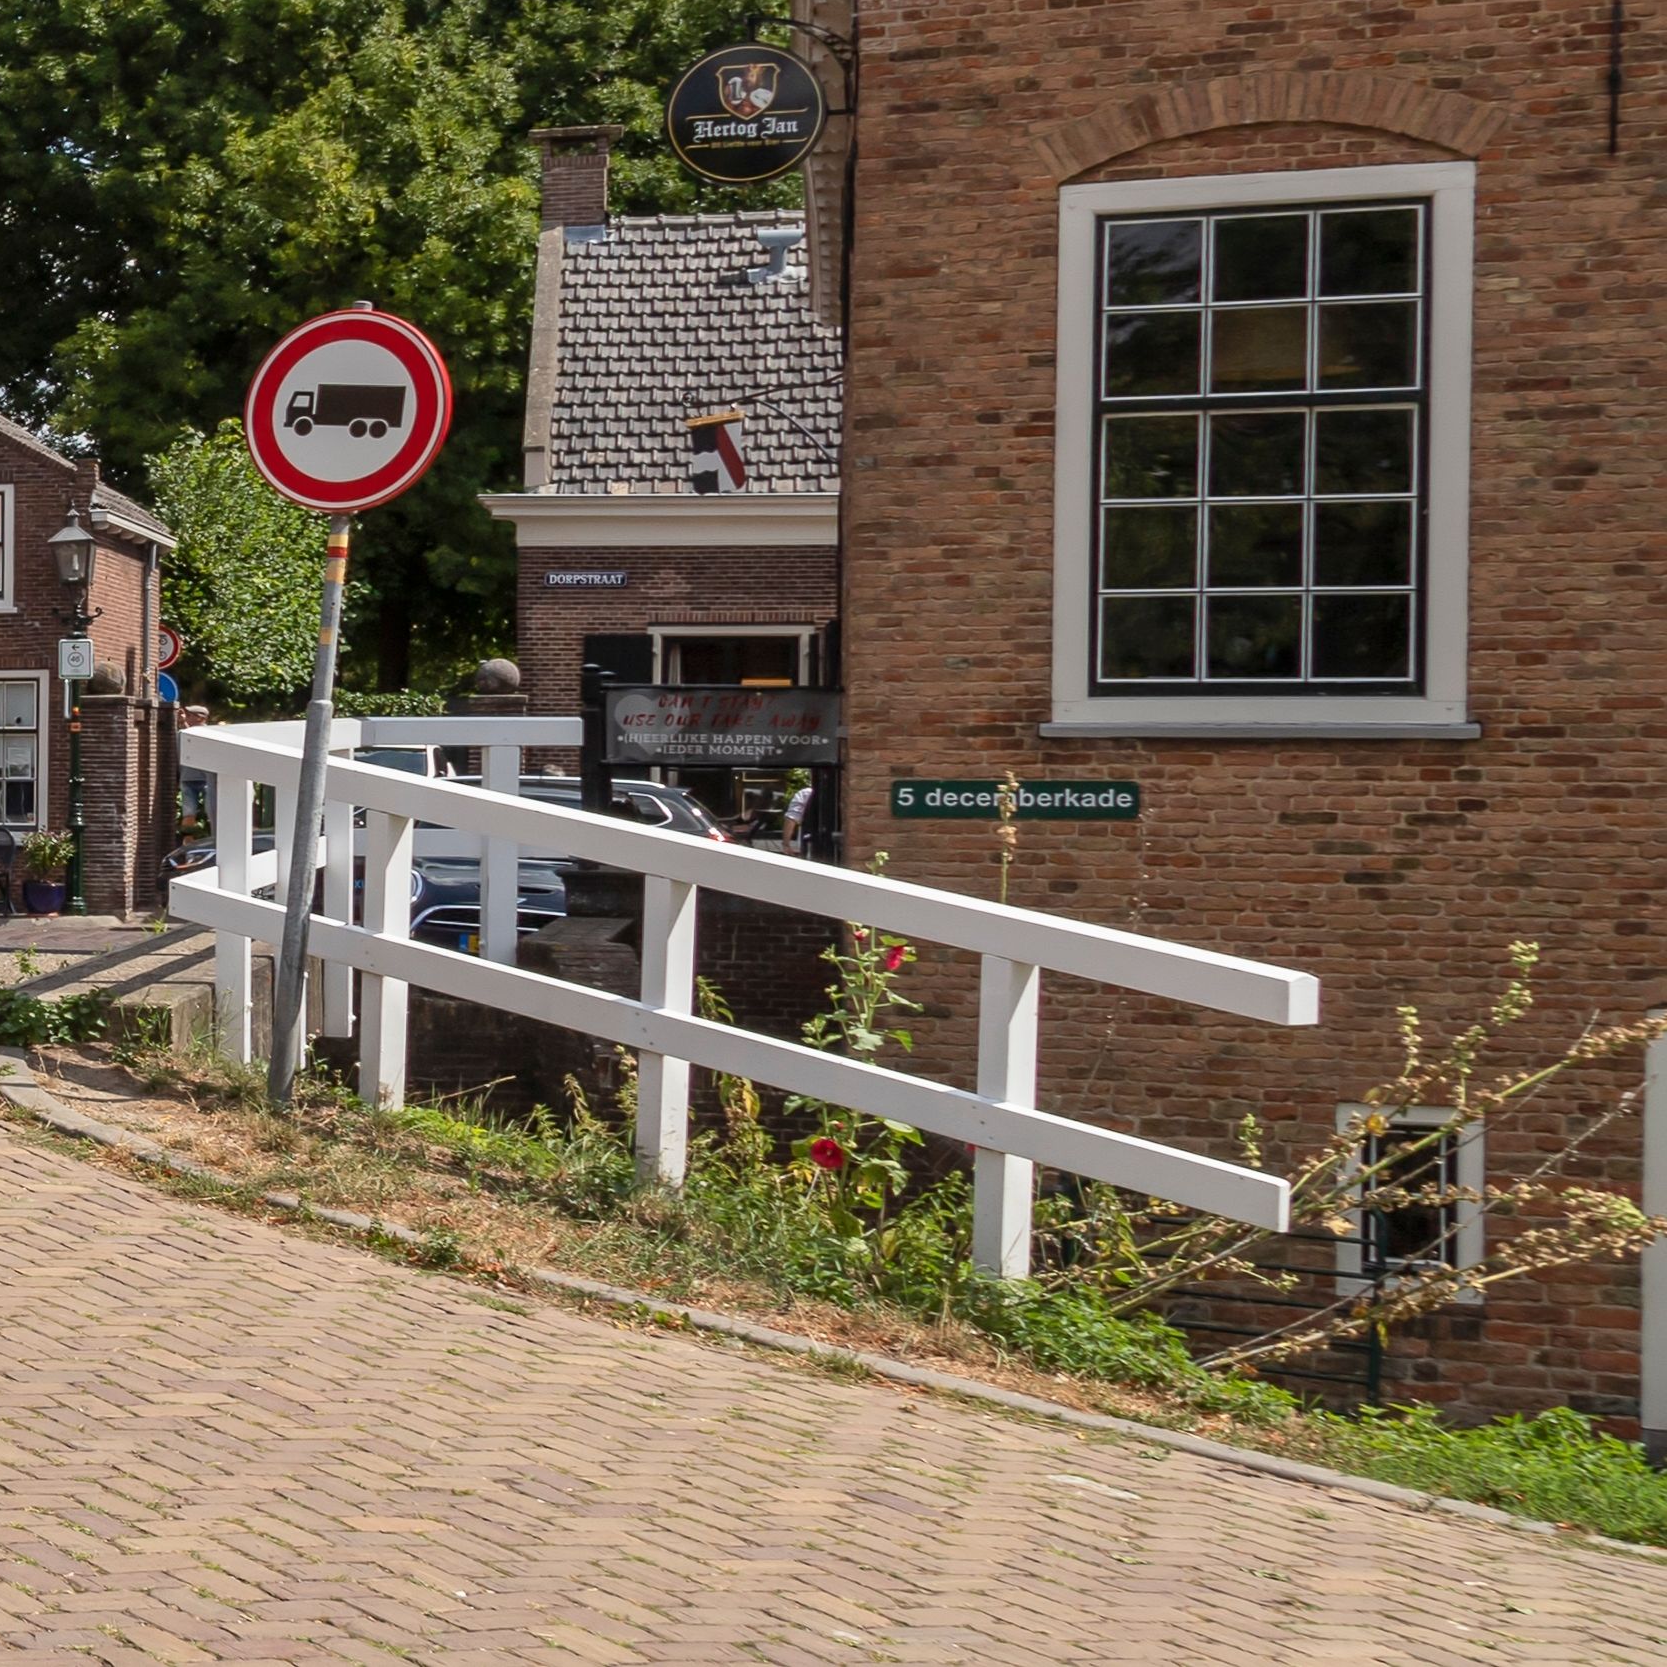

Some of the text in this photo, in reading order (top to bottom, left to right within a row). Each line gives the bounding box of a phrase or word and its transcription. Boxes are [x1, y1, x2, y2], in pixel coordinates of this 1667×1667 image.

[692, 117, 798, 143] Hertog Jan
[549, 574, 624, 585] DORPSTRAAT
[623, 713, 656, 727] USE
[664, 713, 701, 727] OUR
[712, 734, 772, 745] HAPPEN
[778, 735, 821, 746] VOOR
[663, 744, 775, 756] IEDER MOMENT
[897, 787, 915, 807] 5
